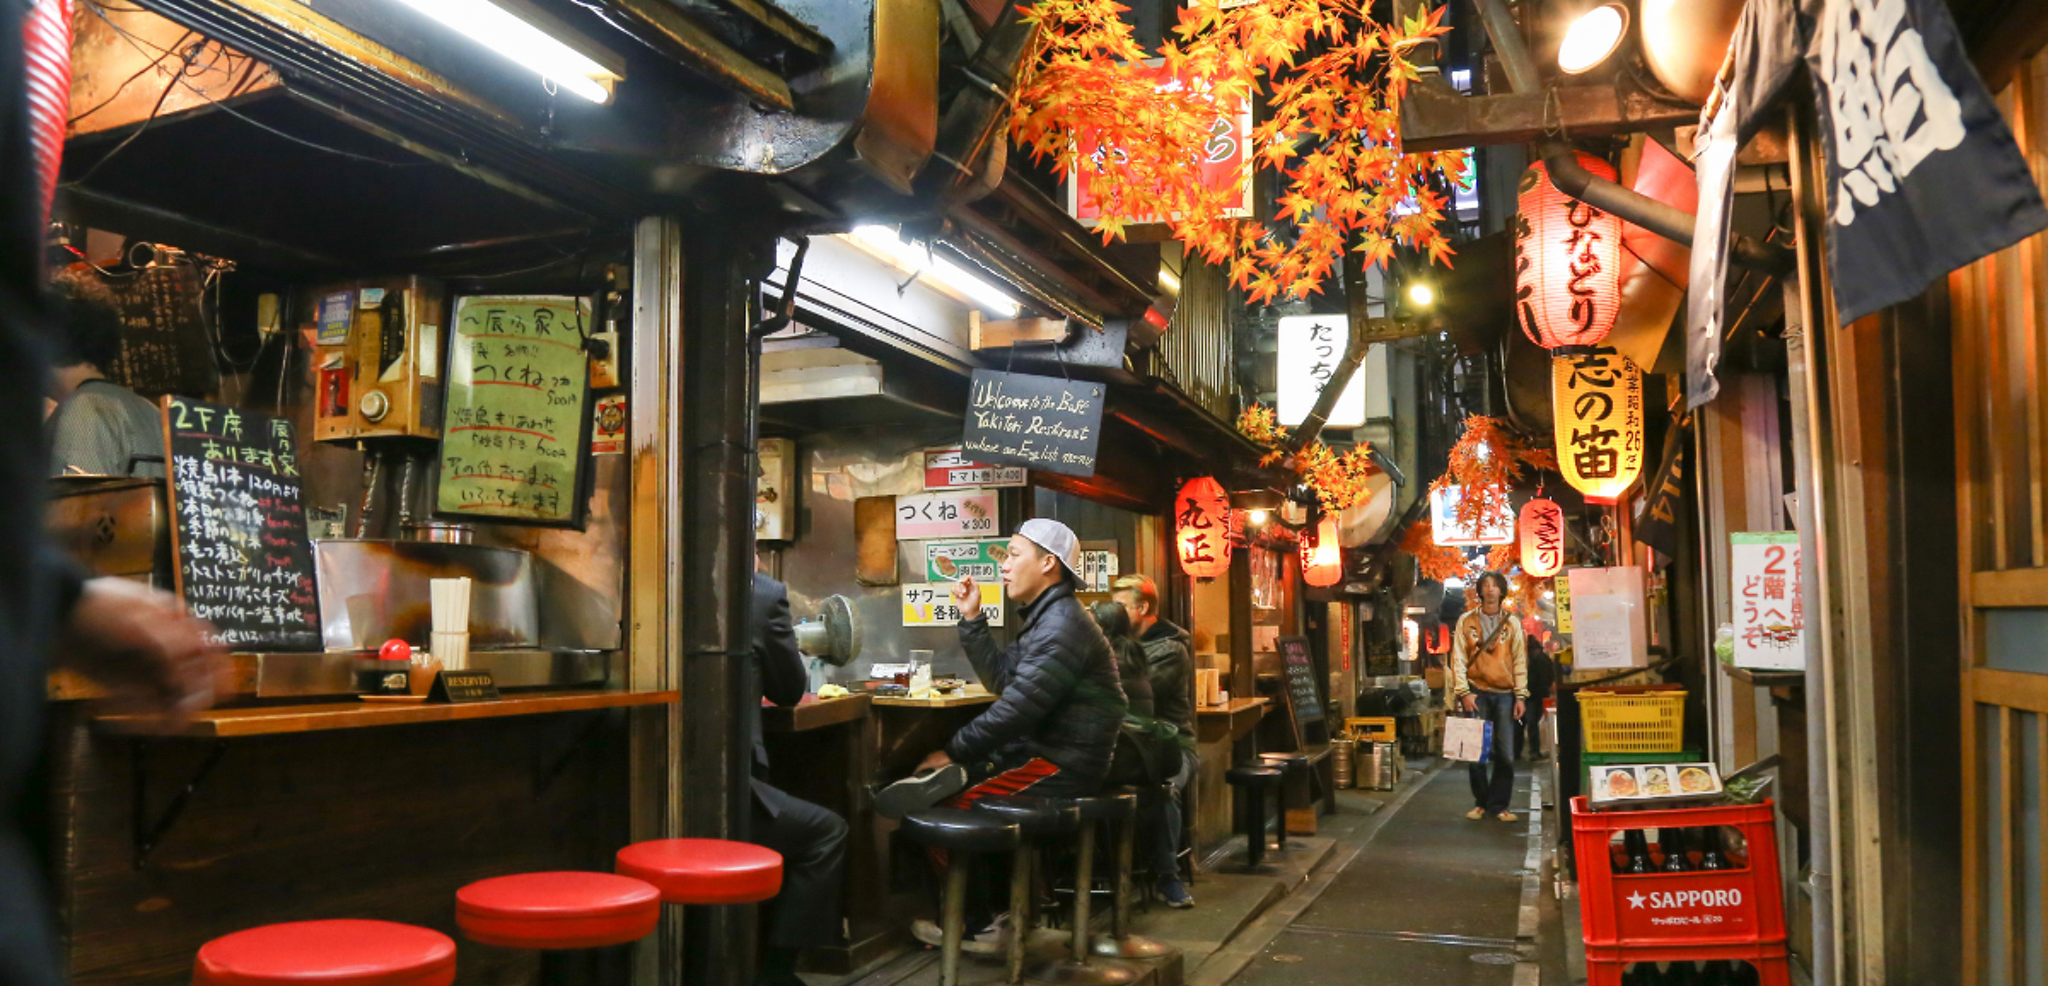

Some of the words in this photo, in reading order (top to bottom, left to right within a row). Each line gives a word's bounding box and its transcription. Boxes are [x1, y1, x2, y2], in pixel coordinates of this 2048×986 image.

[1561, 199, 1602, 336] ひなどり
[473, 363, 544, 386] つくね
[1310, 323, 1333, 396] たっちゃ
[972, 379, 1029, 410] Welcome
[1029, 395, 1040, 410] to
[1568, 345, 1622, 480] 志の笛
[201, 438, 278, 475] あります
[899, 500, 958, 521] つくね
[962, 518, 991, 530] ¥300
[1180, 498, 1216, 564] 丸正
[960, 565, 994, 576] 肉詰め
[1764, 545, 1787, 621] 2階へ
[906, 589, 950, 603] サワー
[1742, 575, 1763, 650] どうぞ
[448, 676, 493, 687] RESERVED
[1649, 888, 1742, 909] SAPPORO
